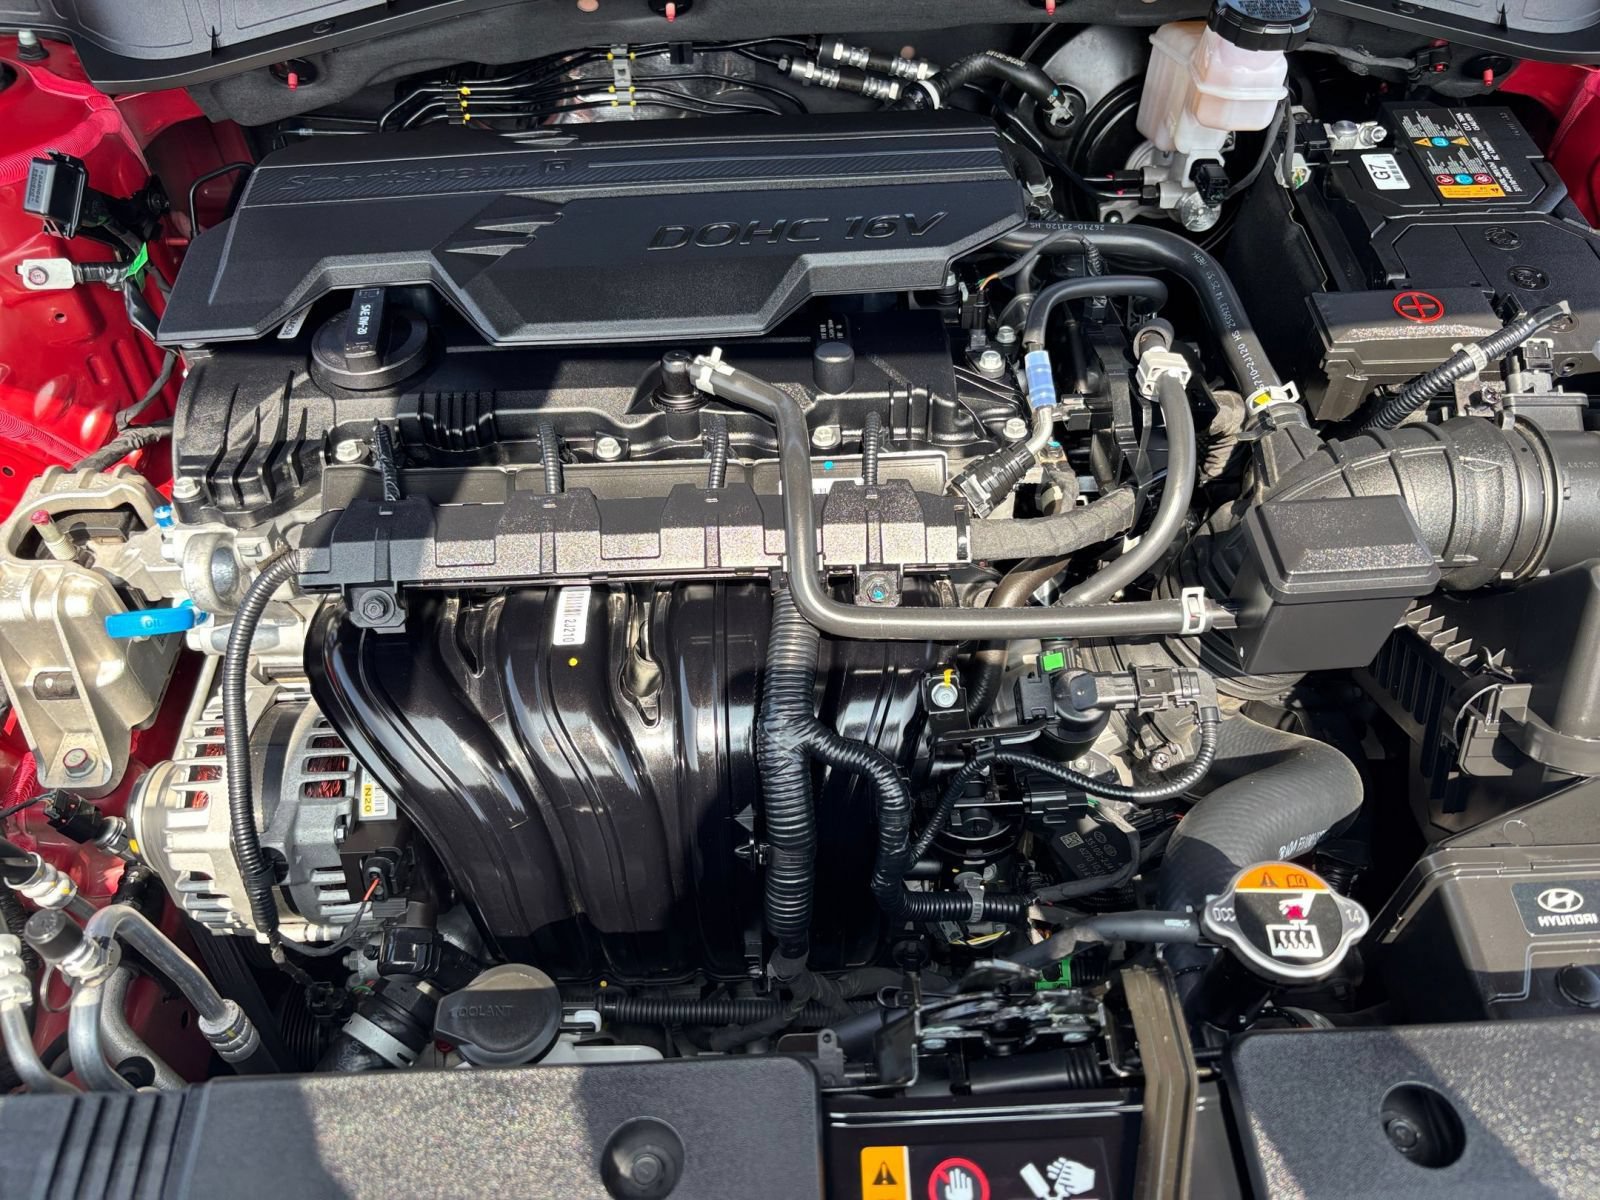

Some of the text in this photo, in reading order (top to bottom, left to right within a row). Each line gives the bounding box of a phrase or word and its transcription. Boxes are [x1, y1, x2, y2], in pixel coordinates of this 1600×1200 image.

[279, 164, 528, 191] Smartstream
[1368, 164, 1391, 180] G7
[647, 211, 950, 251] DOHC 16V
[1046, 222, 1105, 231] 26710-2J120
[360, 304, 371, 316] SAE
[357, 316, 370, 335] 0W-20
[1231, 329, 1242, 341] HS
[1238, 343, 1265, 391] 6710-2J120
[562, 618, 577, 643] 2J210
[364, 787, 372, 812] N20
[1537, 913, 1599, 928] HYUNDAI
[448, 1004, 513, 1018] COOLANT
